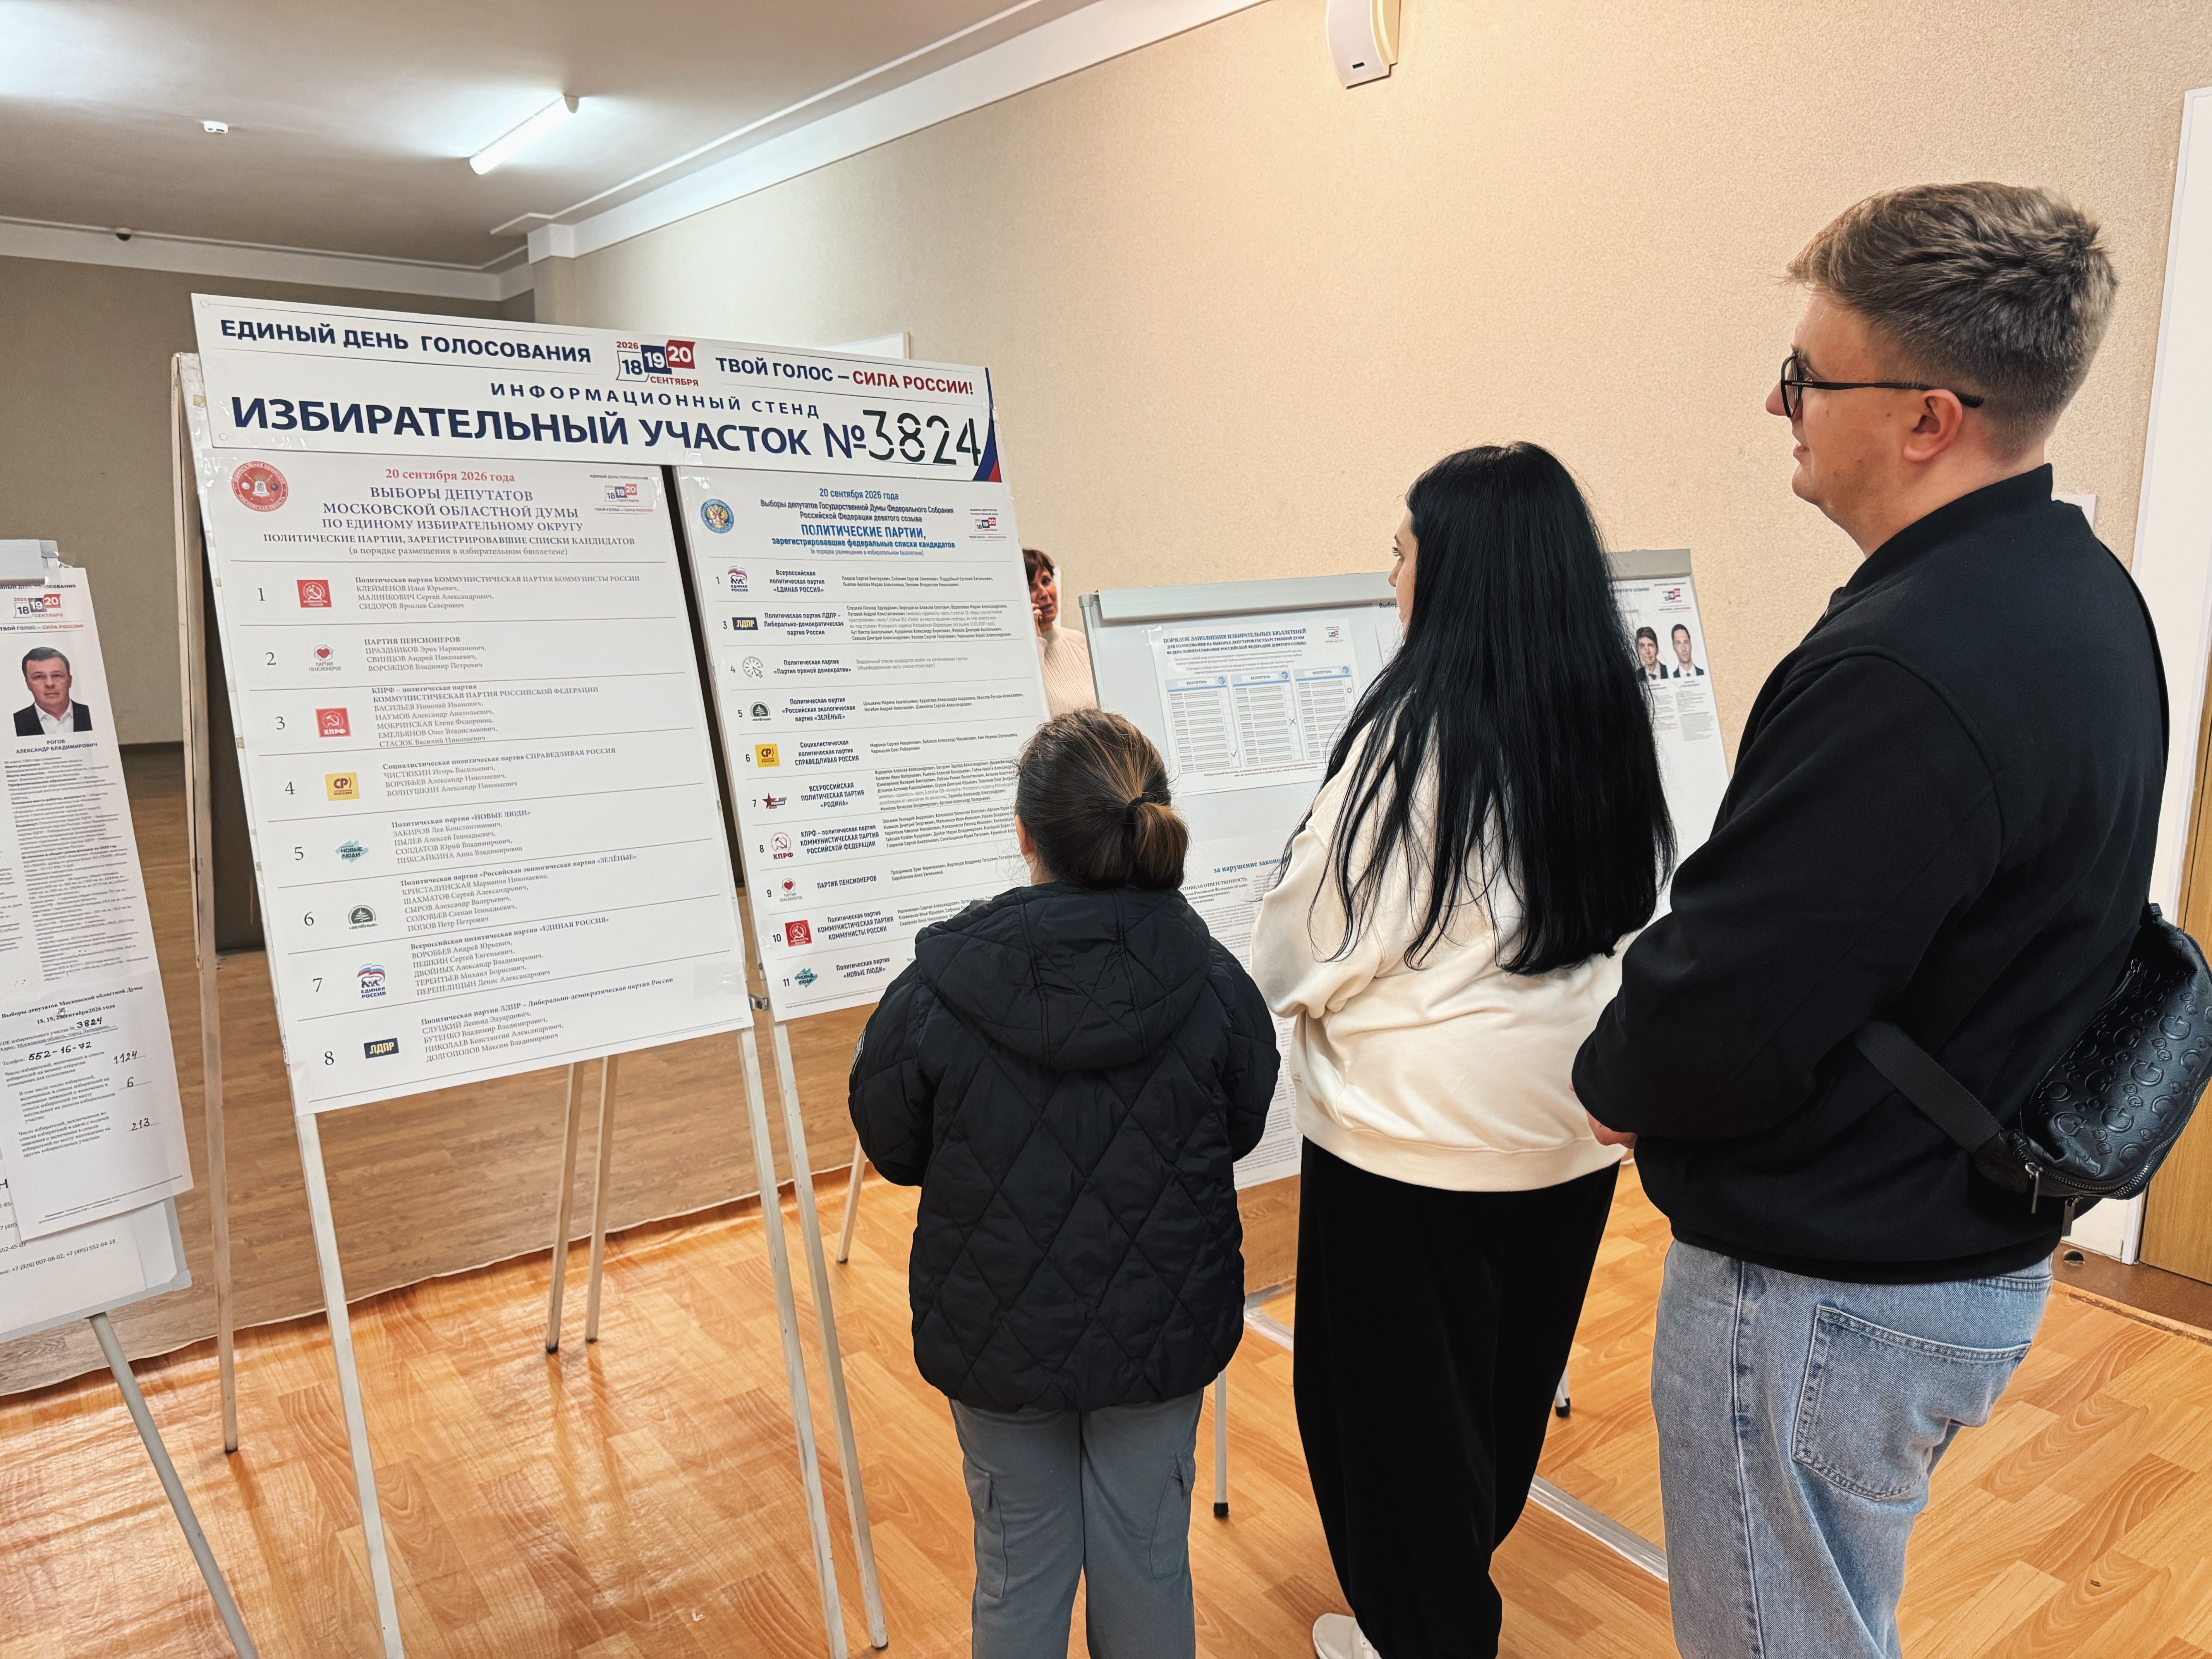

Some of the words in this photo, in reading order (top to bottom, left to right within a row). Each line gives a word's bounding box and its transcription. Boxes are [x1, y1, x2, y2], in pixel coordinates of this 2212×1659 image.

[220, 319, 336, 344] ЕДИНЫЙ
[343, 329, 409, 349] ДЕНЬ
[421, 336, 591, 363] ГОЛОСОВАНИЯ
[617, 342, 639, 350] 2026
[622, 359, 644, 374] 18
[644, 350, 666, 368] 19
[666, 346, 692, 364] 20
[650, 376, 699, 386] СЕНТЯБРЯ
[715, 357, 768, 376] ТВОЙ
[773, 362, 833, 382] ГОЛОС
[853, 371, 900, 388] СИЛА
[903, 375, 974, 395] РОССИИ!
[491, 383, 740, 410] ИНФОРМАЦИОННЫЙ
[752, 400, 819, 419] СТЕНД
[232, 397, 629, 445] ИЗБИРАТЕЛЬНЫЙ
[638, 419, 812, 455] УЧАСТОК
[385, 469, 399, 479] 20
[402, 470, 457, 483] сентября
[461, 471, 487, 481] 2026
[490, 474, 515, 483] года
[370, 487, 441, 499] ВЫБОРЫ
[445, 489, 533, 501] ДЕПУТАТОВ
[819, 488, 829, 497] 20
[830, 489, 864, 500] сентября
[864, 490, 882, 499] 2026
[883, 493, 899, 501] года
[323, 503, 436, 515] МОСКОВСКОЙ
[440, 505, 532, 517] ОБЛАСТНОЙ
[536, 508, 579, 519] ДУМЫ
[760, 499, 787, 509] Выборы
[787, 502, 818, 510] депутатов
[819, 501, 869, 511] Государственной
[869, 504, 886, 513] Думы
[887, 504, 927, 514] Федерального
[927, 506, 954, 515] Собрания
[800, 511, 837, 519] Российской
[838, 512, 873, 522] Федерации
[322, 519, 343, 528] ПО
[346, 519, 413, 531] ЕДИНОМУ
[417, 520, 534, 531] ИЗБИРАТЕЛЬНОМУ
[537, 522, 583, 531] ОКРУГУ
[801, 524, 883, 537] ПОЛИТИЧЕСКИЕ
[884, 527, 926, 540] ПАРТИИ,
[263, 534, 356, 543] ПОЛИТИЧЕСКИЕ
[357, 535, 405, 544] ПАРТИИ,
[407, 536, 527, 544] ЗАРЕГИСТРИРОВАВШИЕ
[772, 538, 846, 547] зарегистрировавшие
[847, 538, 893, 548] федеральные
[349, 546, 358, 555] (в
[360, 548, 396, 556] порядке
[398, 548, 450, 556] размещения
[459, 547, 522, 557] избирательном
[523, 547, 568, 556] бюллетене)
[716, 576, 720, 584] 1
[258, 588, 266, 601] 1
[17, 606, 29, 615] 18
[722, 621, 727, 629] 3
[736, 619, 755, 628] ЛДПР
[1272, 628, 1306, 636] БЮЛЛЕТЕНЕЙ
[266, 652, 276, 665] 2
[738, 709, 743, 718] 5
[276, 716, 285, 730] 3
[50, 743, 98, 751] ВЛАДИМИРОВИЧ
[383, 761, 450, 770] Социалистическая
[526, 750, 584, 759] СПРАВЕДЛИВАЯ
[745, 754, 750, 762] 6
[795, 757, 837, 766] СПРАВЕДЛИВАЯ
[285, 781, 295, 795] 4
[809, 782, 854, 792] ВСЕРОССИЙСКАЯ
[752, 799, 756, 808] 7
[392, 819, 443, 828] Политическая
[471, 812, 503, 820] «НОВЫЕ
[295, 847, 304, 861] 5
[759, 845, 764, 853] 8
[1222, 862, 1257, 872] нарушение
[1259, 857, 1282, 866] законо
[817, 880, 838, 889] ПАРТИЯ
[839, 875, 877, 886] ПЕНСИОНЕРОВ
[767, 889, 772, 898] 9
[304, 912, 314, 926] 6
[817, 919, 874, 933] КОММУНИСТИЧЕСКАЯ
[874, 916, 894, 925] ПАРТИЯ
[773, 934, 781, 943] 10
[828, 929, 866, 940] КОММУНИСТЫ
[866, 926, 887, 934] РОССИИ
[843, 969, 866, 978] «НОВЫЕ
[866, 966, 886, 975] ЛЮДИ»
[313, 977, 322, 992] 7
[783, 978, 790, 987] 11
[2, 1010, 27, 1018] Выборы
[28, 1004, 58, 1013] депутатов
[59, 995, 95, 1006] Московской
[96, 989, 125, 998] областной
[77, 1017, 102, 1029] 3824
[370, 1042, 394, 1055] ЛДПР
[325, 1051, 334, 1065] 8
[127, 1077, 134, 1087] 6
[131, 1118, 150, 1132] 213
